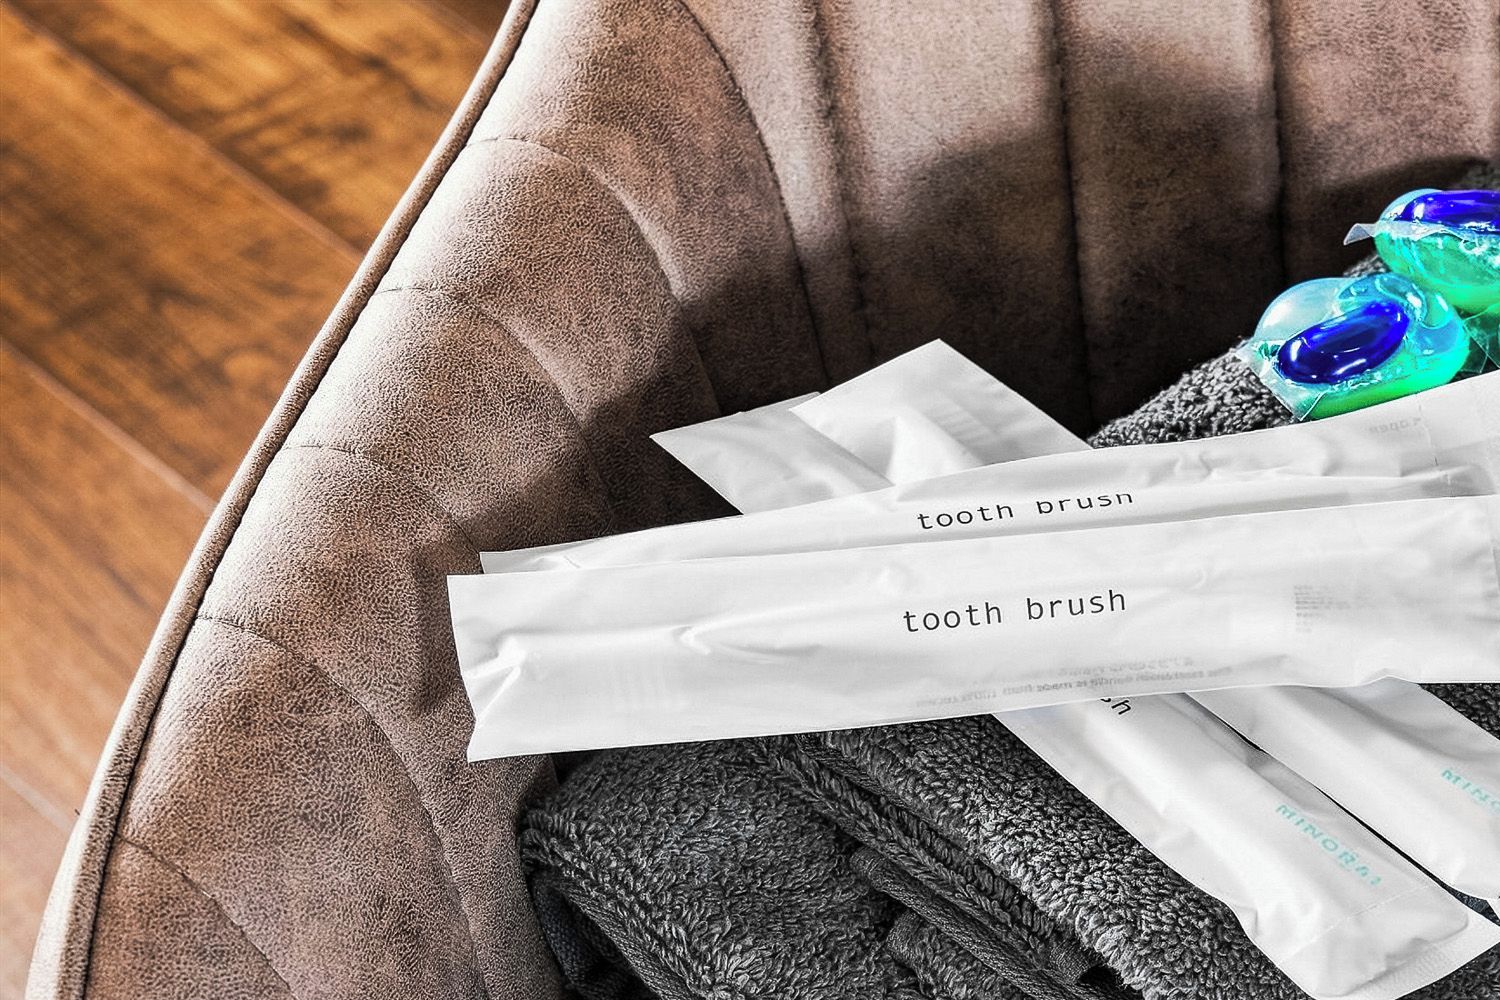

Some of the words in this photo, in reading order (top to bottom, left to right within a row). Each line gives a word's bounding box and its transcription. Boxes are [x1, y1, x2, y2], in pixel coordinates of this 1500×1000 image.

[917, 504, 1014, 530] tooth
[903, 601, 1002, 633] tooth
[1026, 589, 1126, 620] brush
